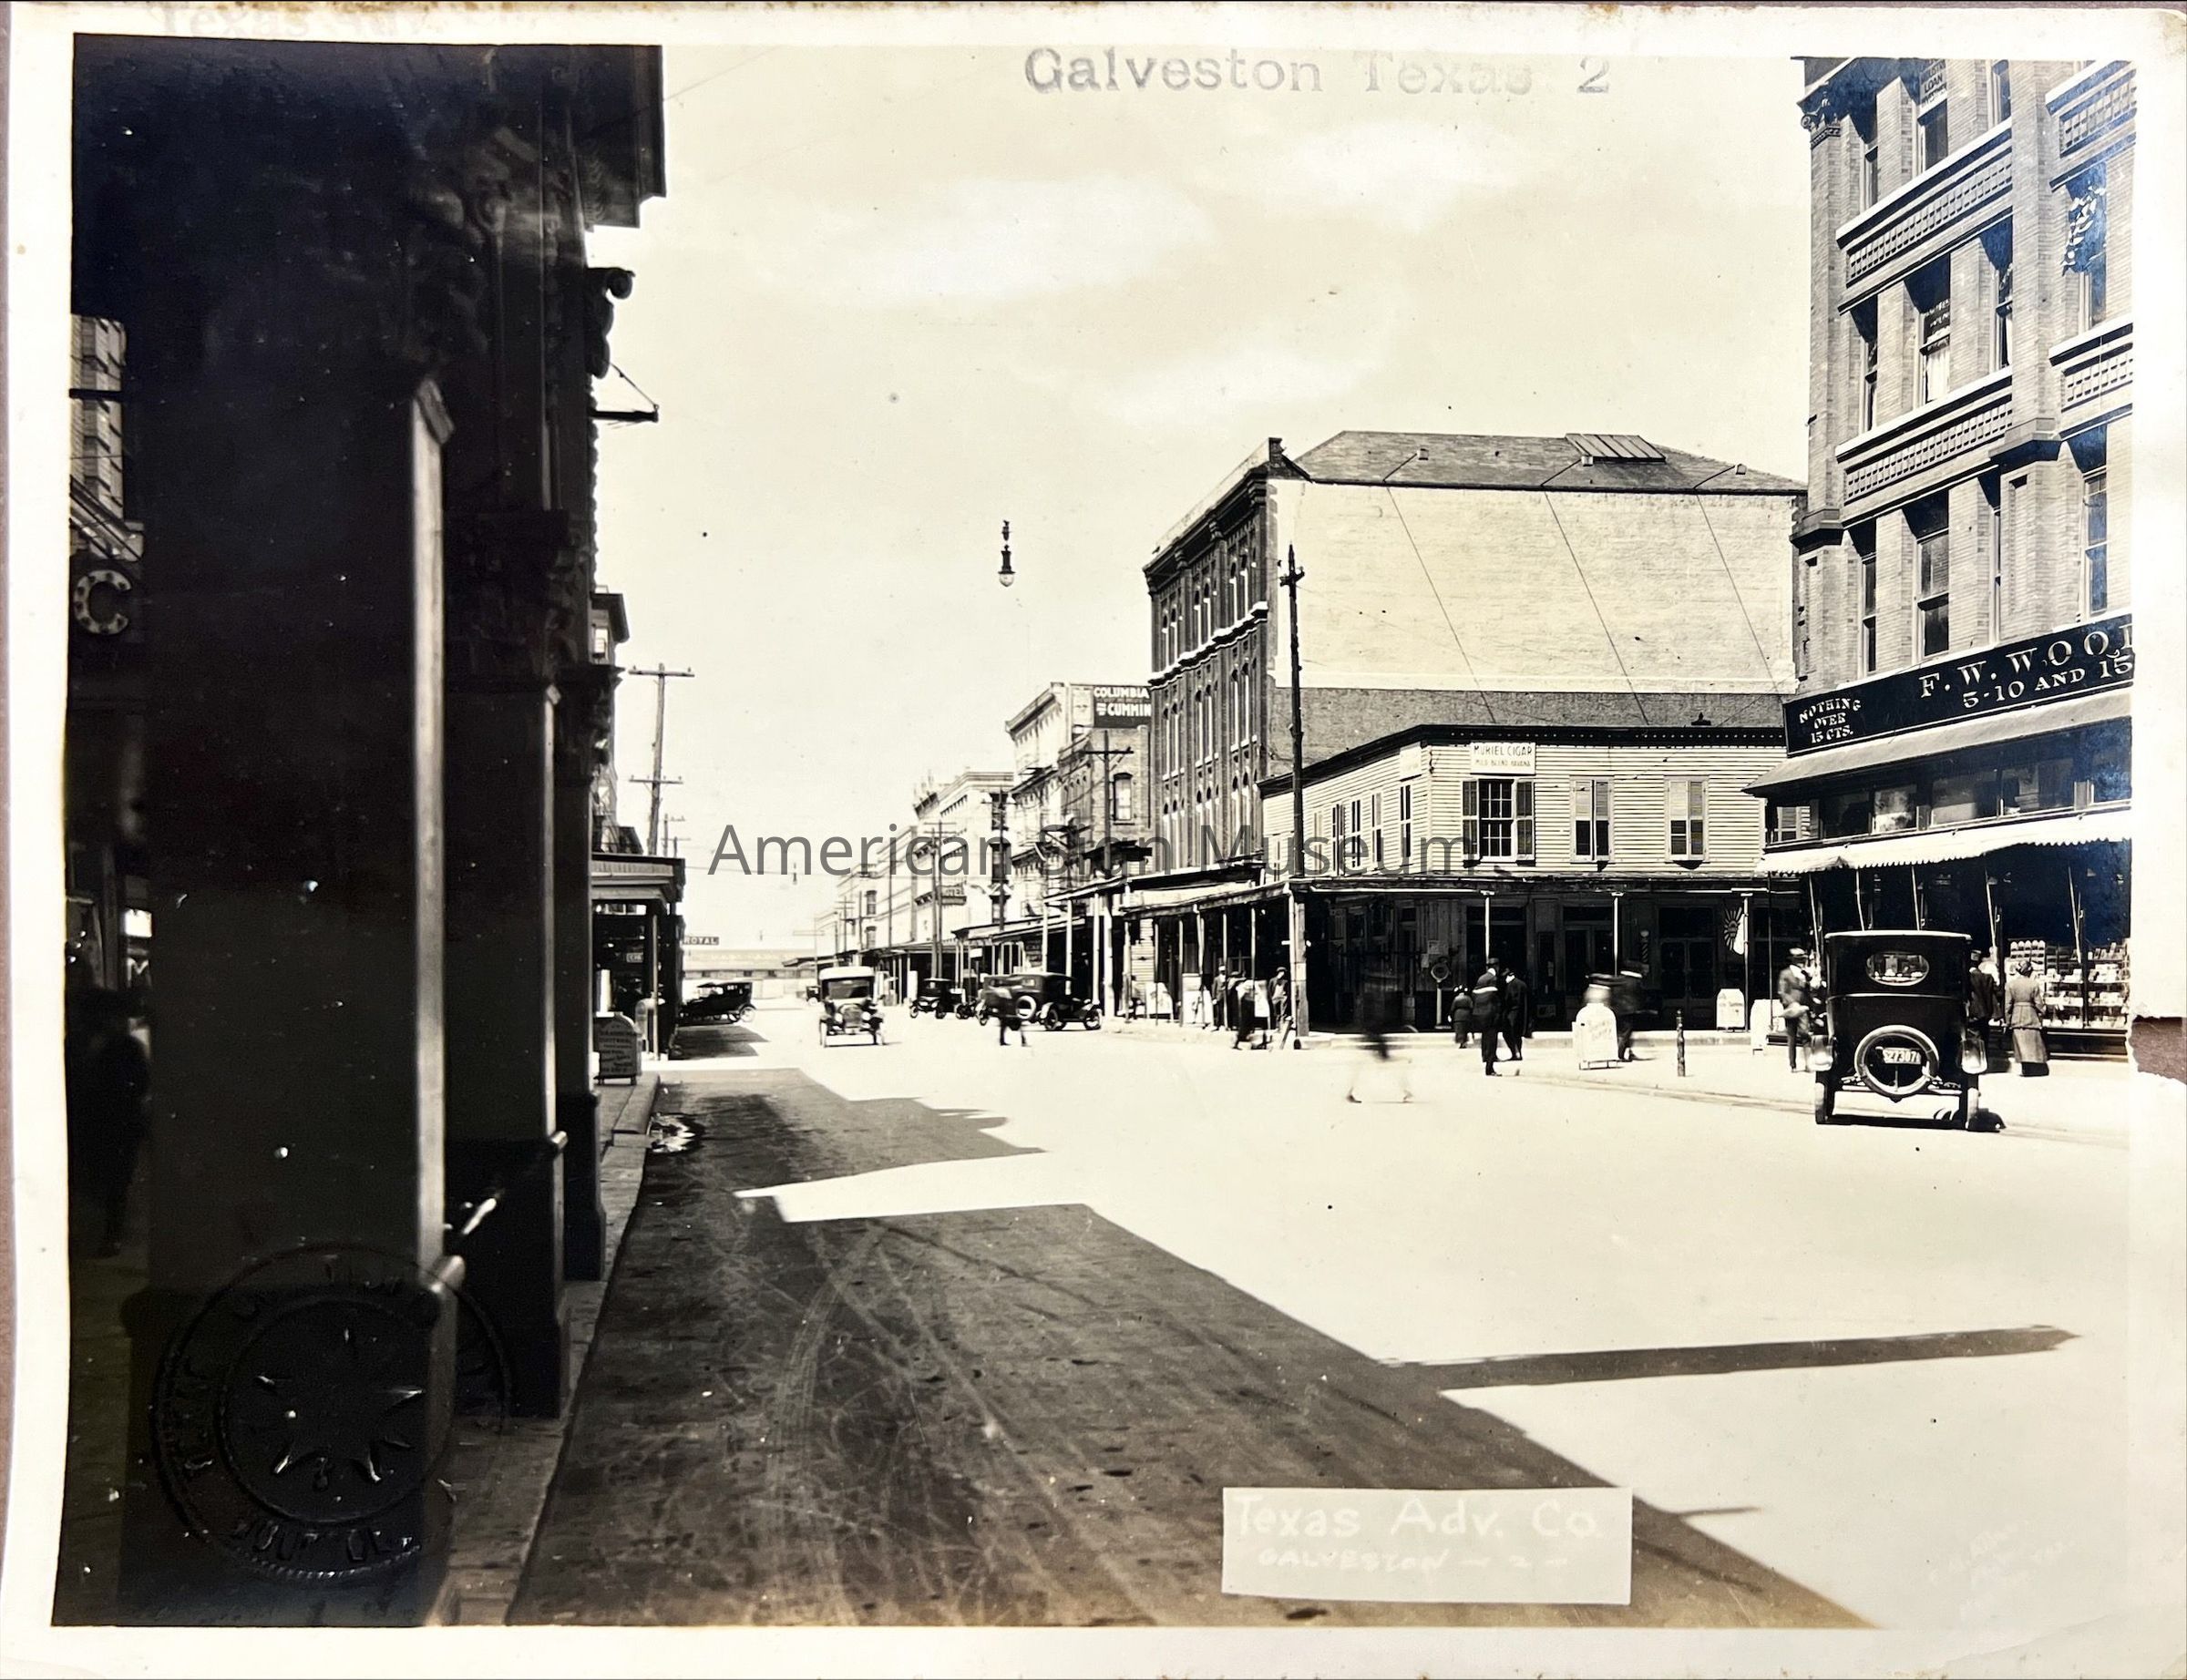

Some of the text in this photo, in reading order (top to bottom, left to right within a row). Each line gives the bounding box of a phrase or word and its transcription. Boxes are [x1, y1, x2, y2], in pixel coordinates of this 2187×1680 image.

[1918, 671, 1951, 699] F.
[1956, 659, 1997, 686] W.
[1962, 654, 2133, 709] 5-10 AND 15
[1094, 687, 1150, 699] COLUMBIA
[1799, 698, 1861, 723] NOTHING
[1813, 712, 1846, 729] OVER
[1810, 724, 1853, 743] 15 CTS.
[1473, 745, 1533, 757] MURIEL CIGAR
